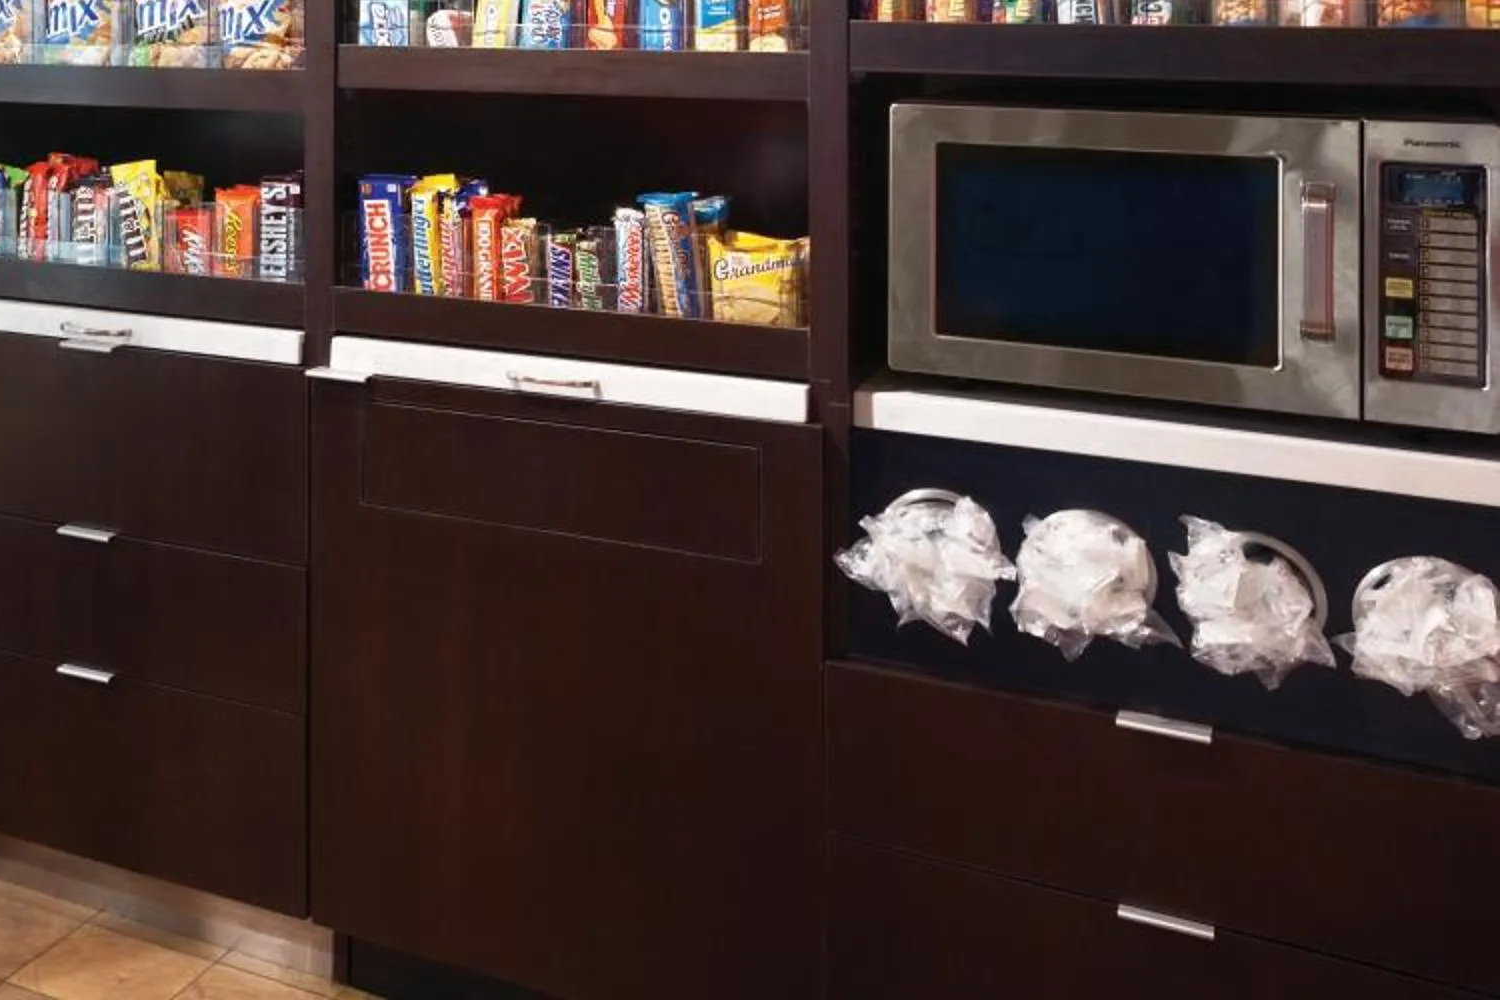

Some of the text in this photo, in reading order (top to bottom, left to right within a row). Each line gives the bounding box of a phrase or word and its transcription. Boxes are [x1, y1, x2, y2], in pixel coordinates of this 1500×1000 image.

[366, 202, 393, 292] CRUNCH
[412, 198, 435, 295] utterfinger
[501, 226, 534, 303] TWIX
[713, 252, 797, 281] Grandm
